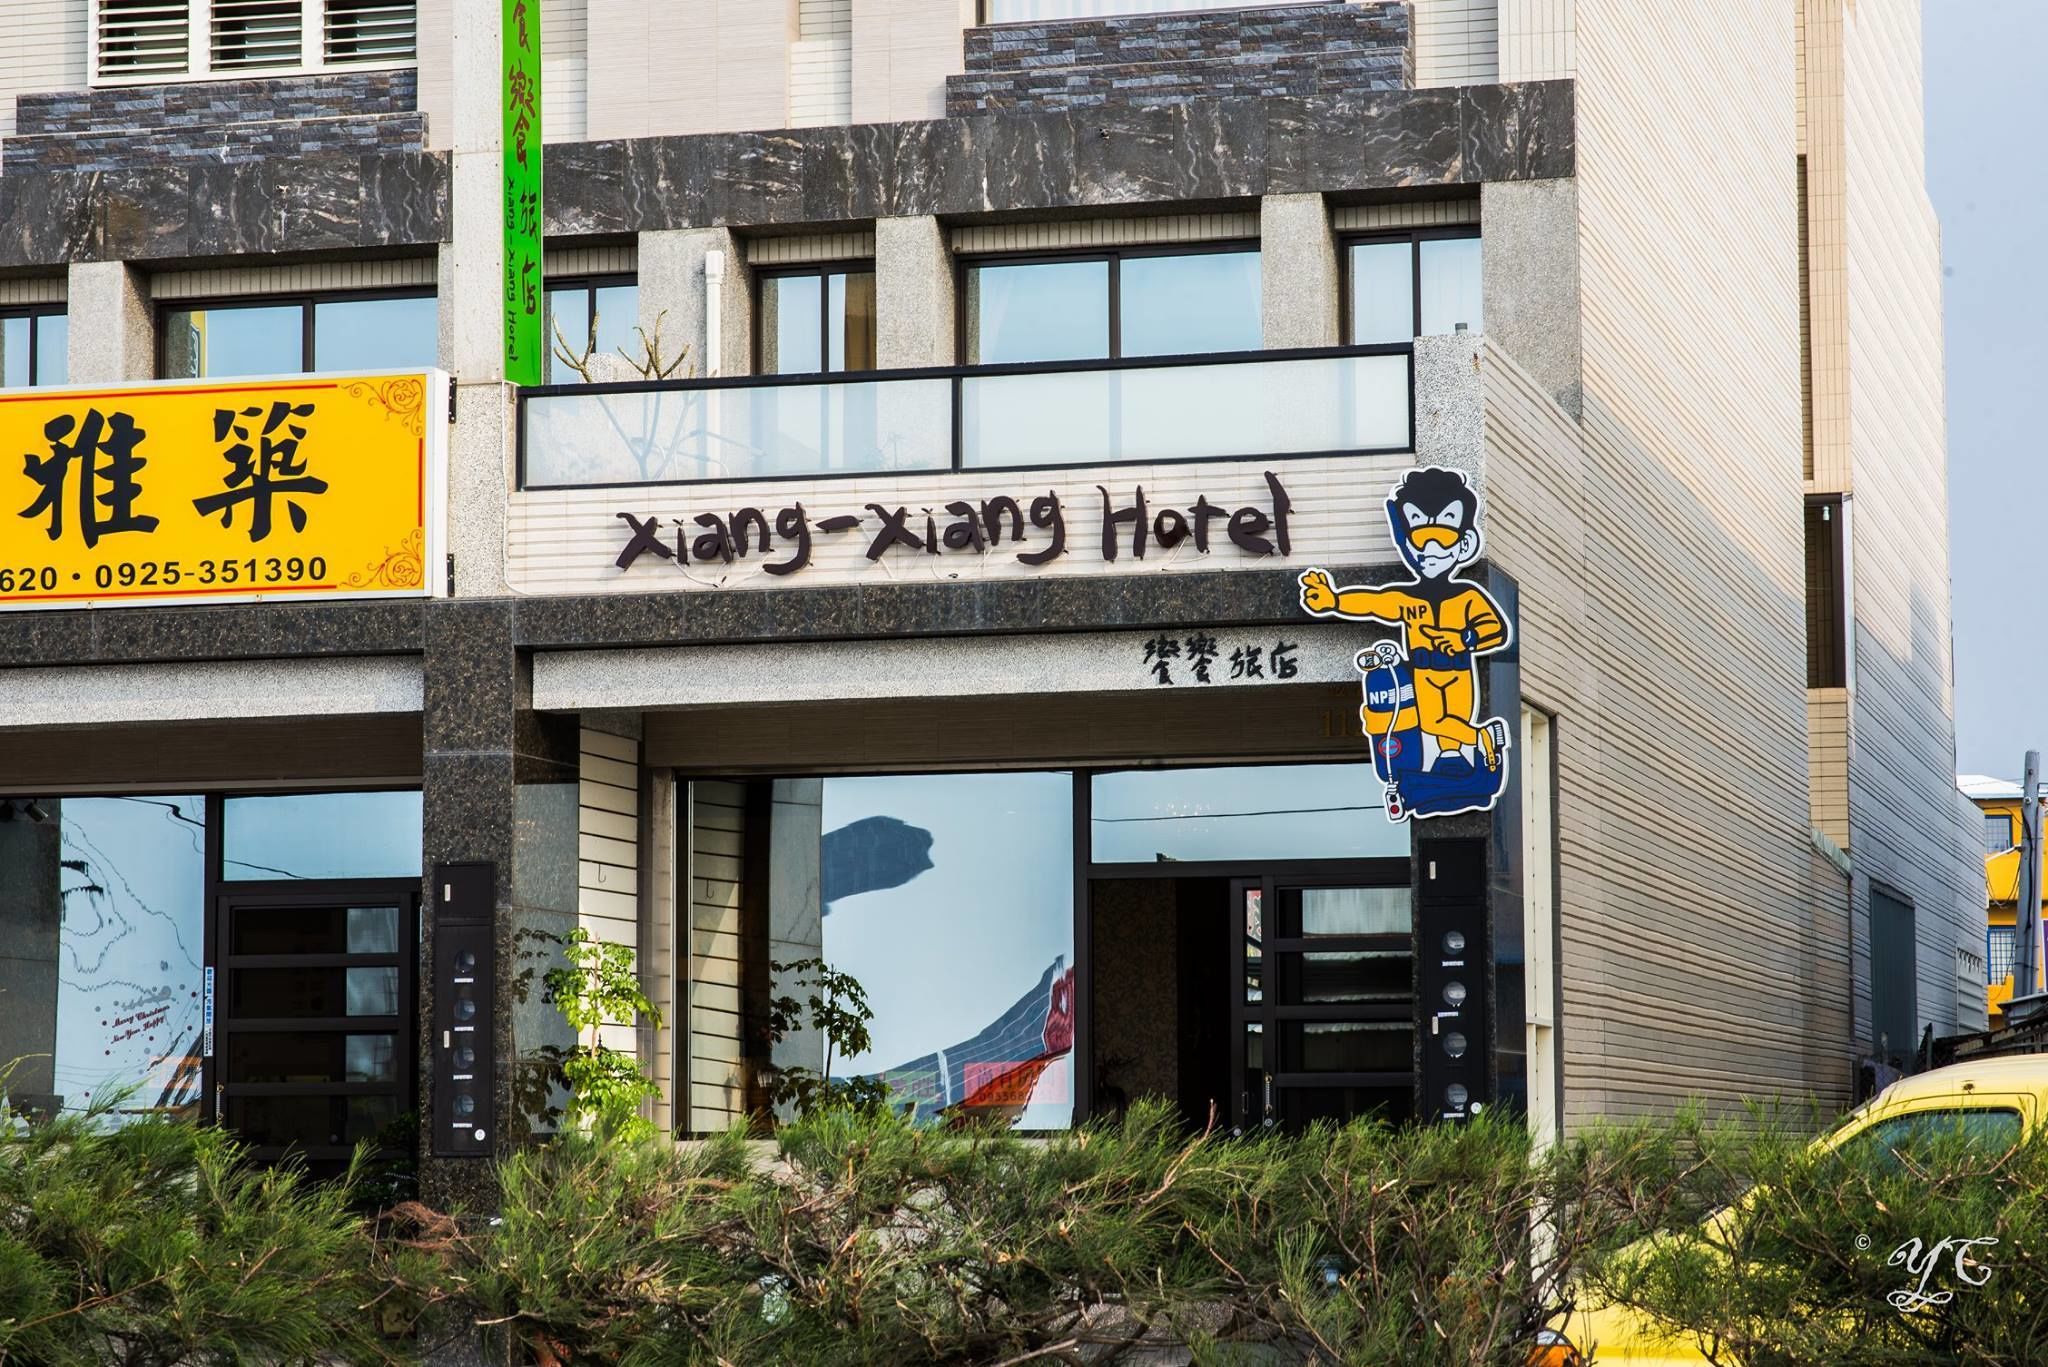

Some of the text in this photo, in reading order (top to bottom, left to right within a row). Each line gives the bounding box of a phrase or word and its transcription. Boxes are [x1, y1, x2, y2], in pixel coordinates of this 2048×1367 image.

[17, 401, 329, 549] 雅築
[1096, 470, 1292, 561] Hotel
[95, 557, 327, 588] 0925-351390
